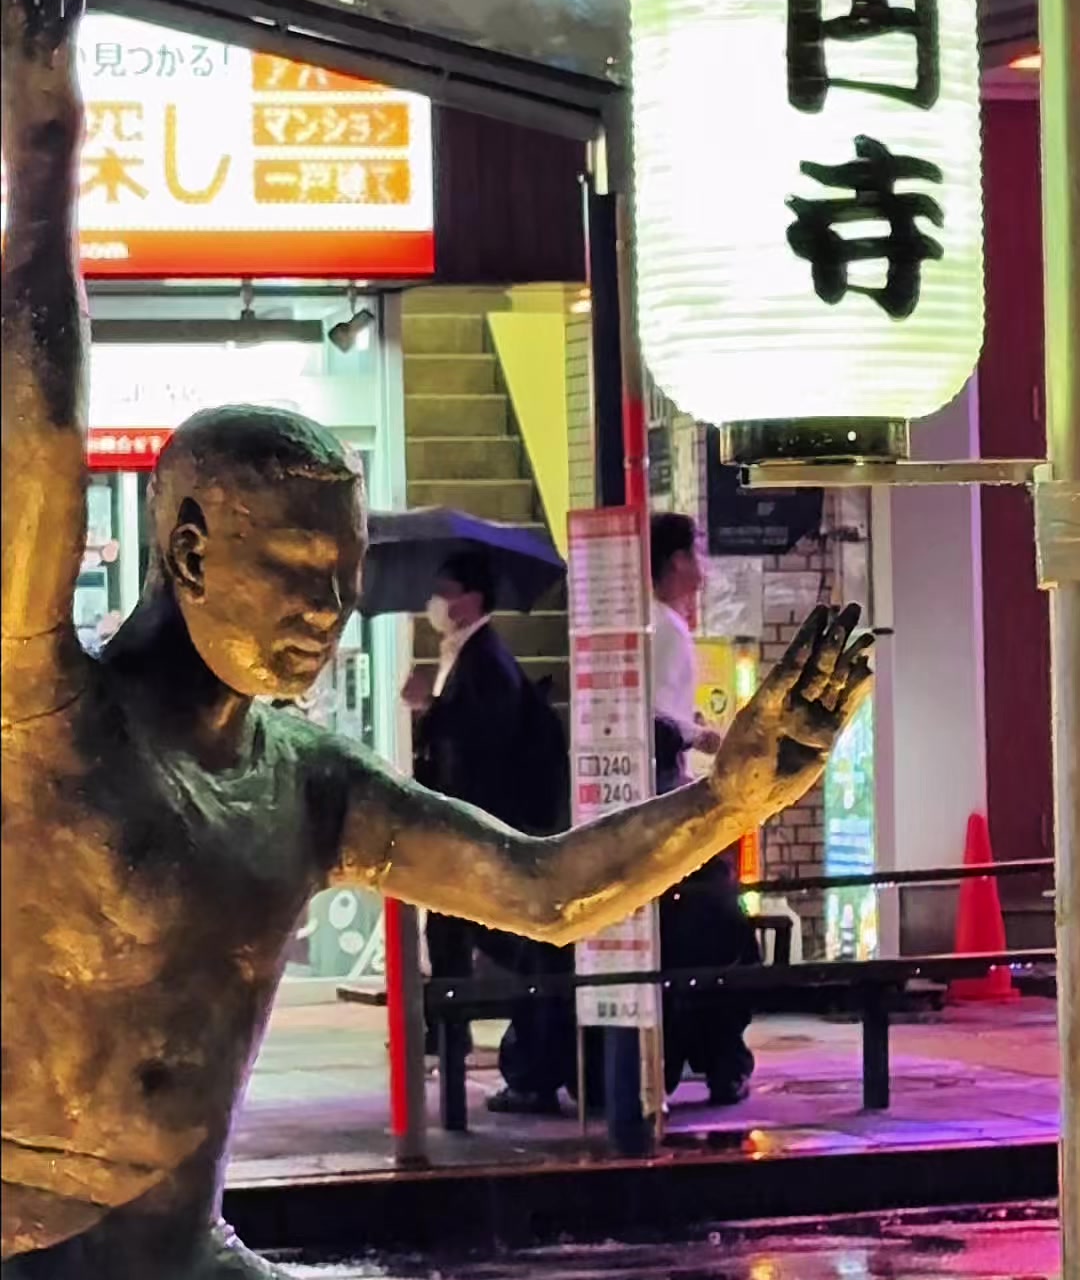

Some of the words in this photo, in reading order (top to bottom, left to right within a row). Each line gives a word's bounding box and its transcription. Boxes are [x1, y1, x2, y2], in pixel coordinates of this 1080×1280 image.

[264, 107, 397, 144] マンション
